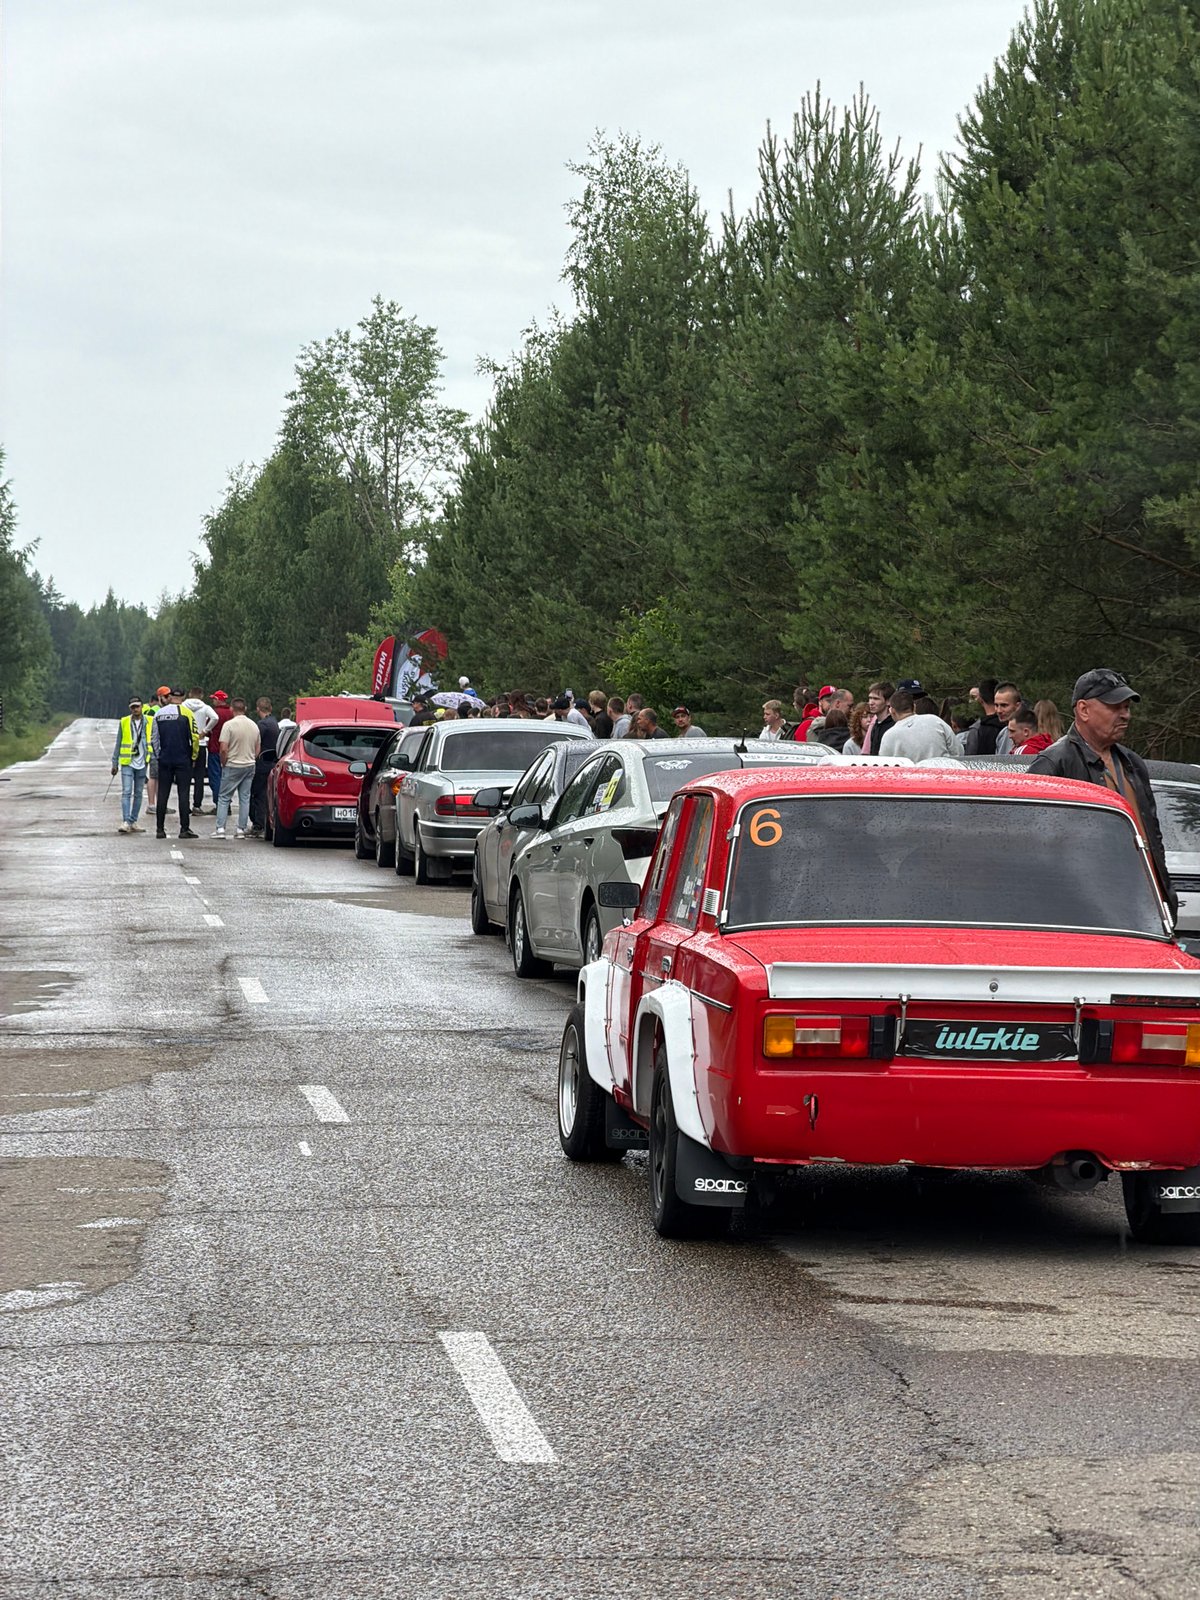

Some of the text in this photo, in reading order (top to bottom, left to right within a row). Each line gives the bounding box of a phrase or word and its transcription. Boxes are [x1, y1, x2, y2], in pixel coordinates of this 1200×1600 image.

[337, 809, 357, 817] Н018
[749, 807, 783, 847] 6
[934, 1026, 1041, 1051] iulskie
[694, 1177, 748, 1193] sparc
